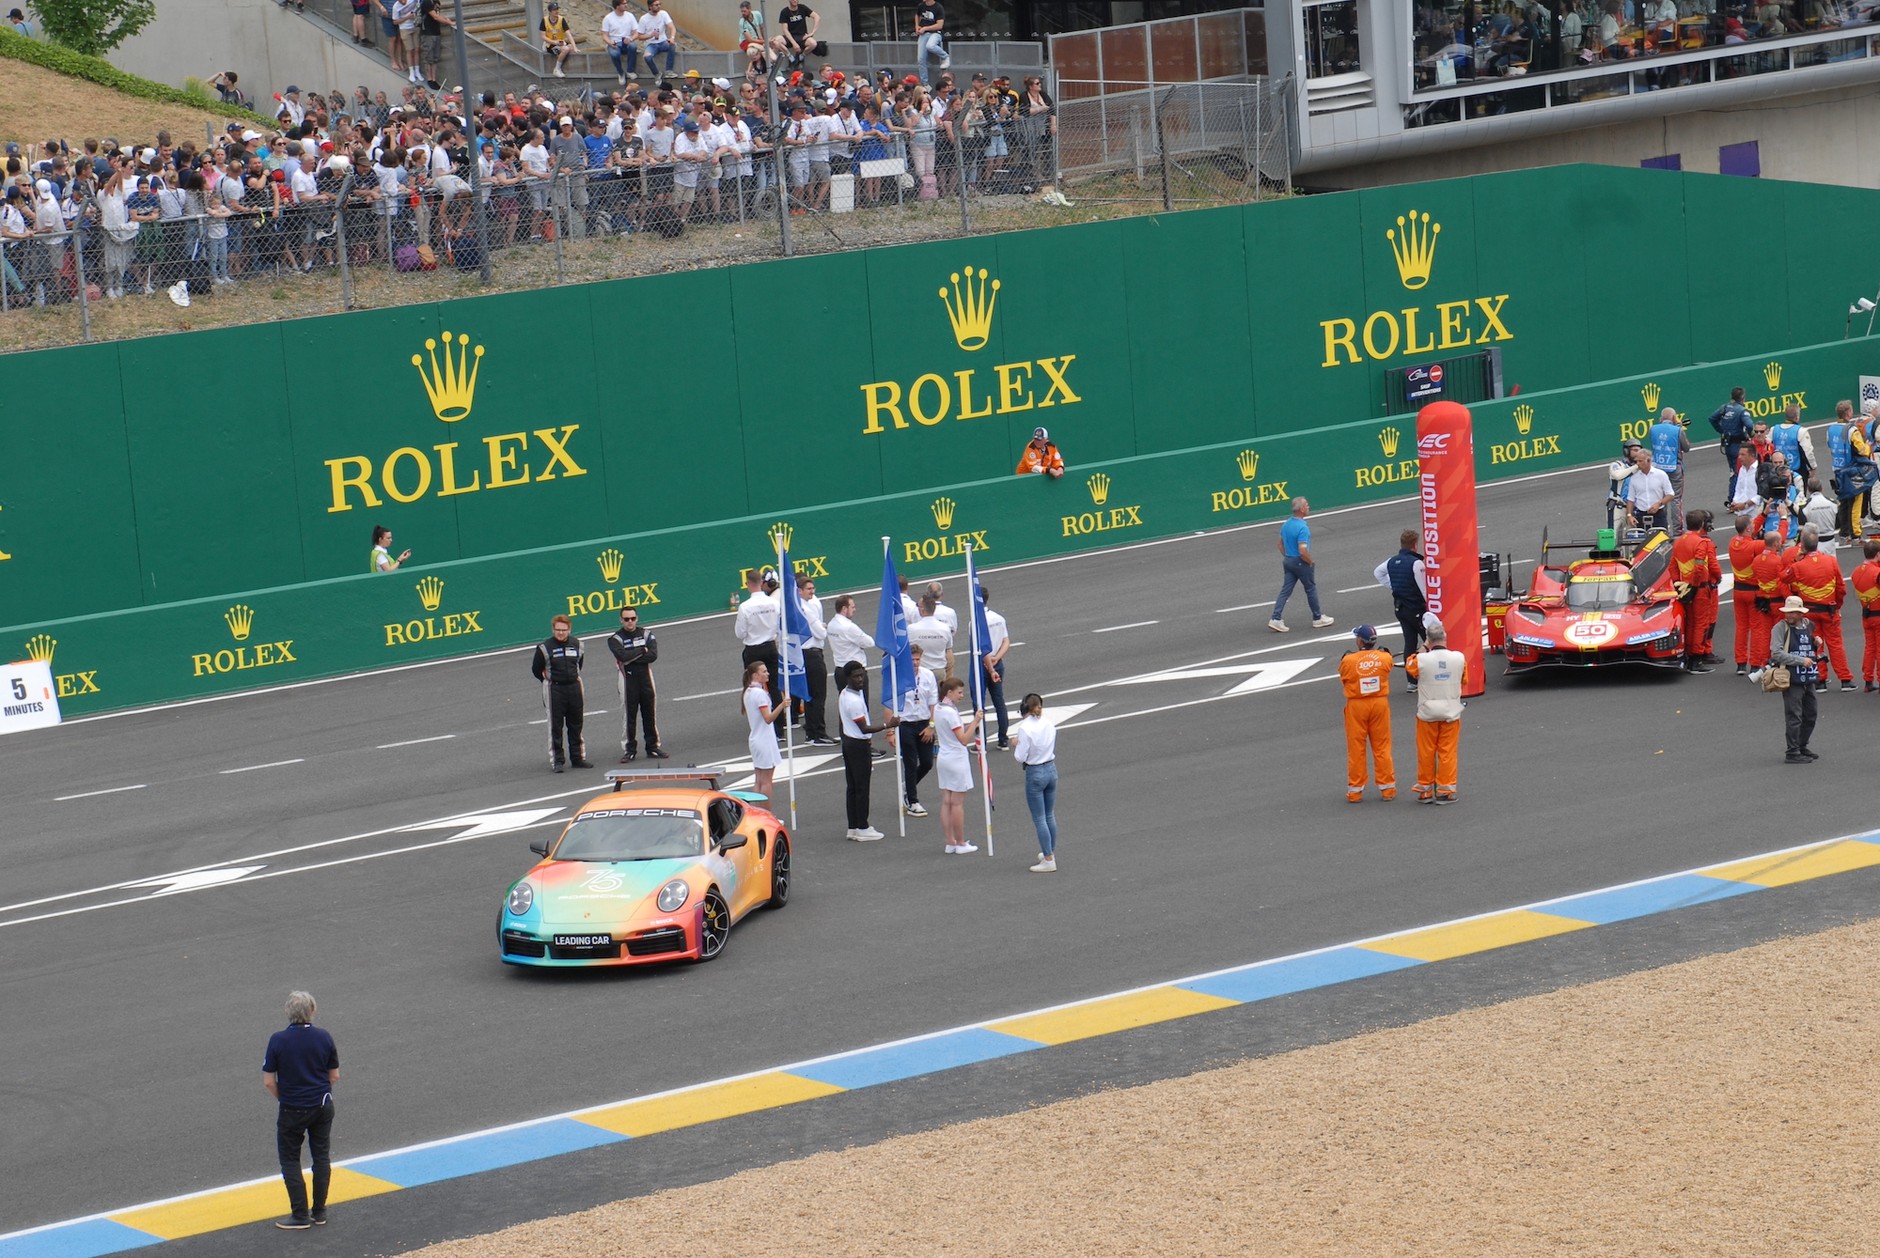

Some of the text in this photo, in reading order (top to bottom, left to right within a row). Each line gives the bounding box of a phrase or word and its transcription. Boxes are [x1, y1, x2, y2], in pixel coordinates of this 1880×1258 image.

[1320, 295, 1514, 368] ROLEX
[860, 355, 1082, 435] ROLEX
[1492, 436, 1562, 465] ROLEX
[324, 425, 588, 513] ROLEX
[1212, 482, 1290, 512] ROLEX
[1062, 506, 1143, 537] ROLEX
[1421, 473, 1440, 569] POSITION
[905, 531, 990, 562] ROLEX
[566, 583, 661, 617] ROLEX
[1427, 575, 1443, 614] OLE
[385, 612, 483, 646] ROLEX
[1576, 625, 1606, 636] 50
[193, 641, 297, 677] ROLEX
[1359, 660, 1374, 669] 100
[11, 678, 27, 701] 5
[4, 701, 44, 717] MINUTES
[577, 809, 695, 821] PORSCHE
[579, 869, 626, 893] 75
[555, 935, 610, 946] LEADING CAR
